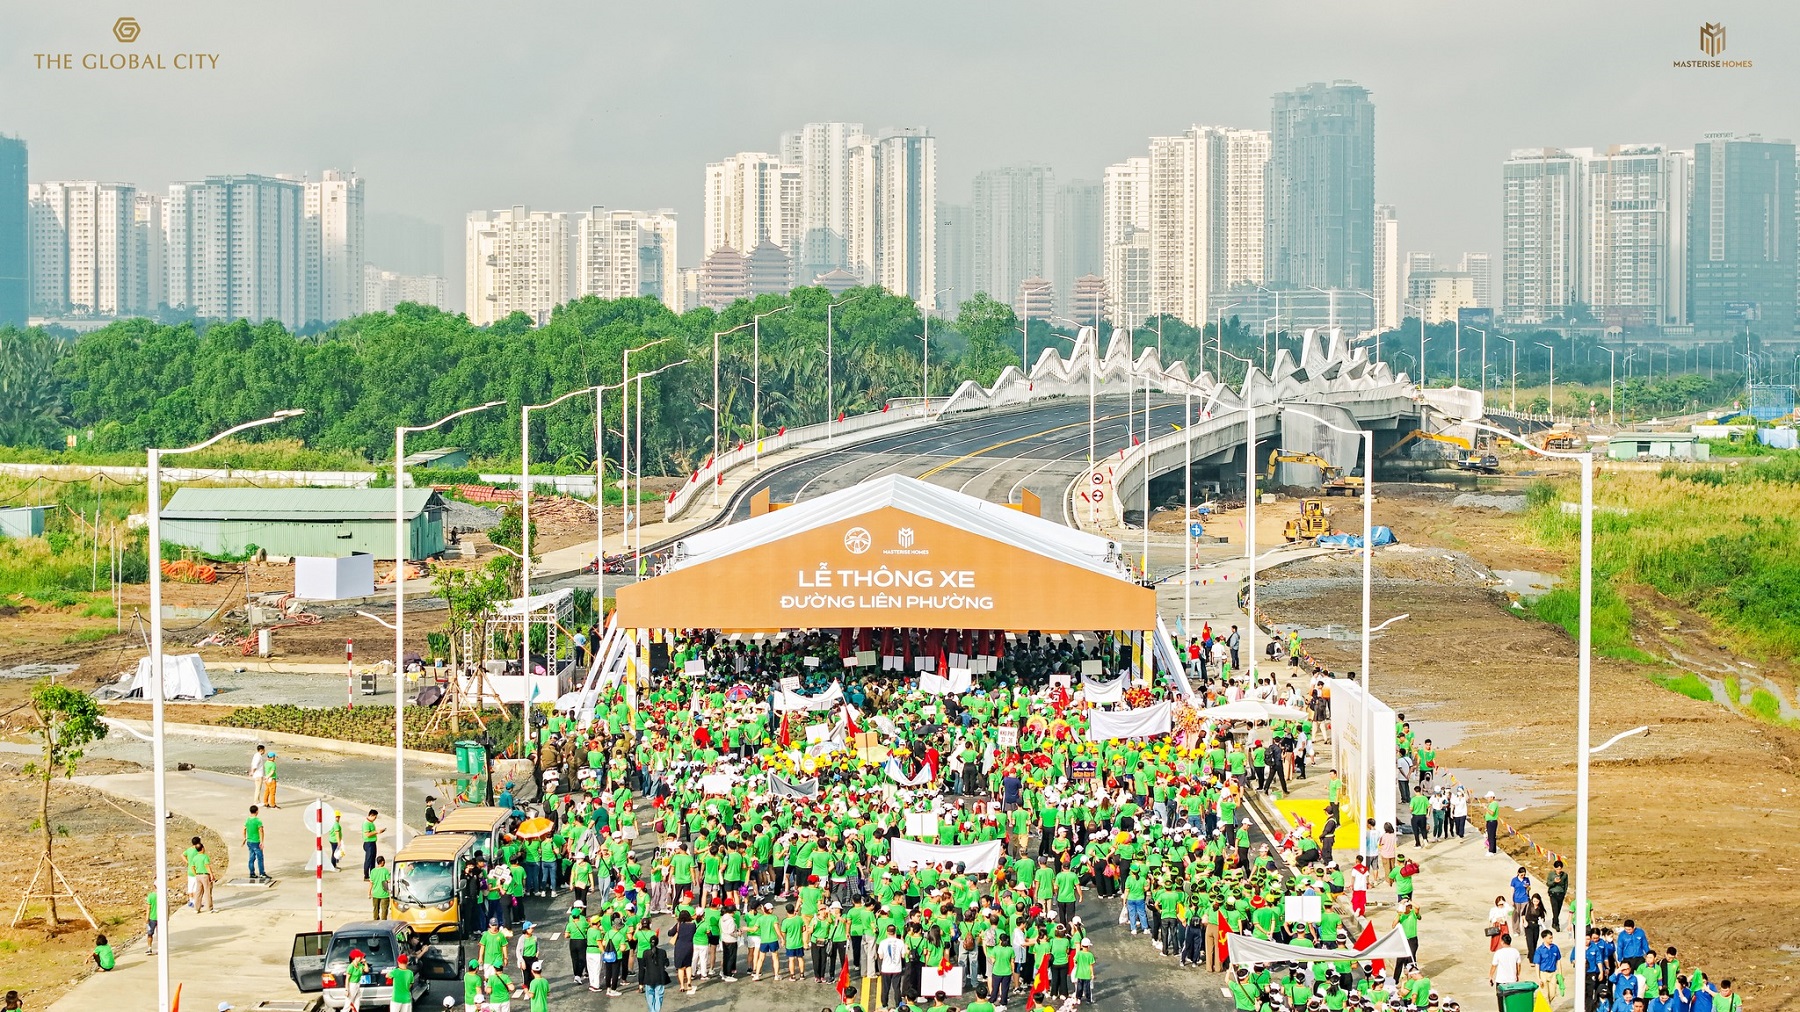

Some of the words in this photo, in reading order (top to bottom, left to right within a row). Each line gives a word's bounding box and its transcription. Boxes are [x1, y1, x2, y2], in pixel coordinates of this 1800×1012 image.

[798, 562, 832, 588] LỄ
[837, 565, 934, 588] THÔNG
[938, 570, 976, 588] XE
[780, 592, 856, 609] ĐƯỜNG
[859, 592, 901, 609] LIÊN
[906, 593, 994, 610] PHƯỜNG
